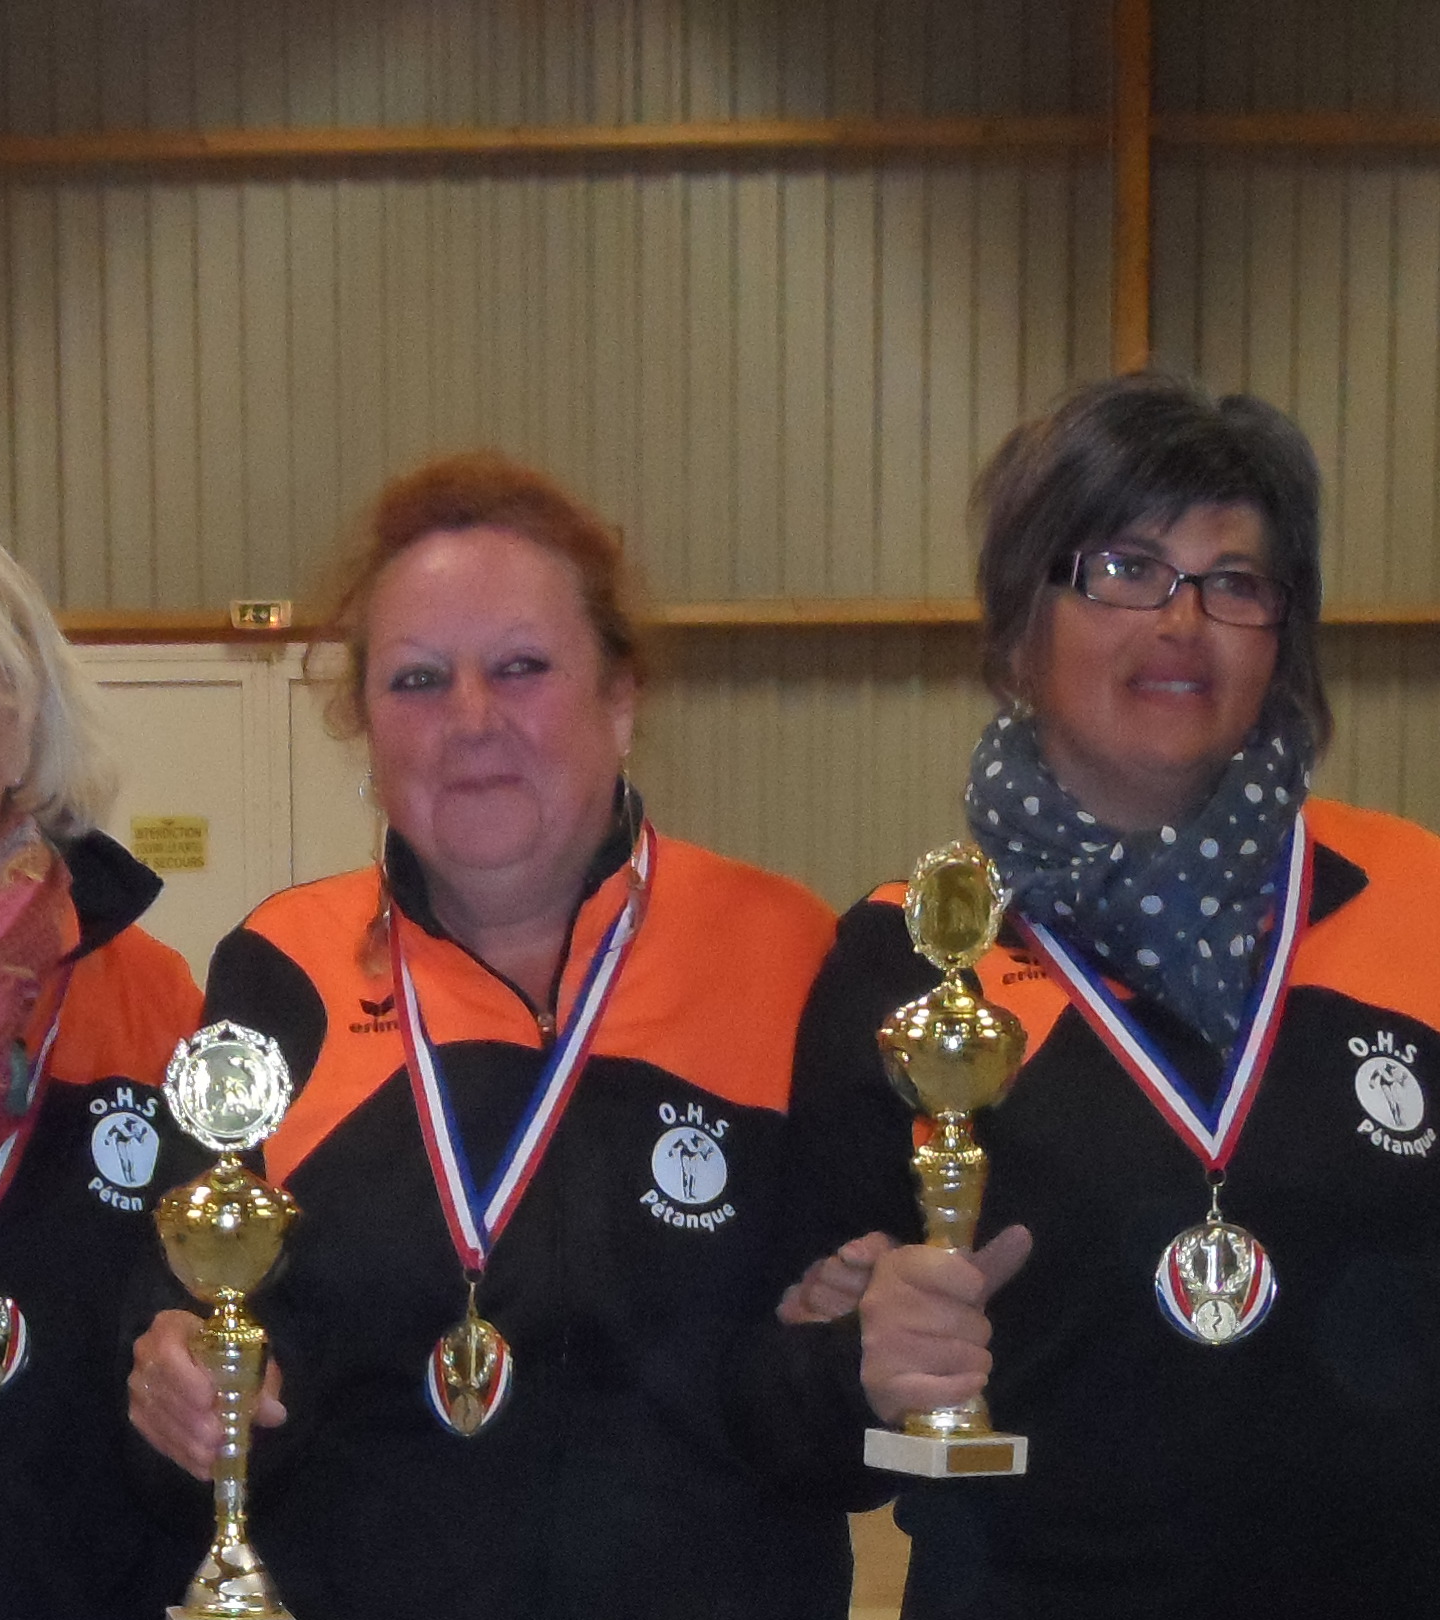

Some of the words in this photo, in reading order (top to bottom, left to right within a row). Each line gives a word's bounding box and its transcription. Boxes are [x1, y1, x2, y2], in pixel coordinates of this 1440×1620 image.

[1357, 1118, 1437, 1158] Pétanque
[88, 1176, 144, 1212] Pétan
[639, 1188, 736, 1232] Pétanque
